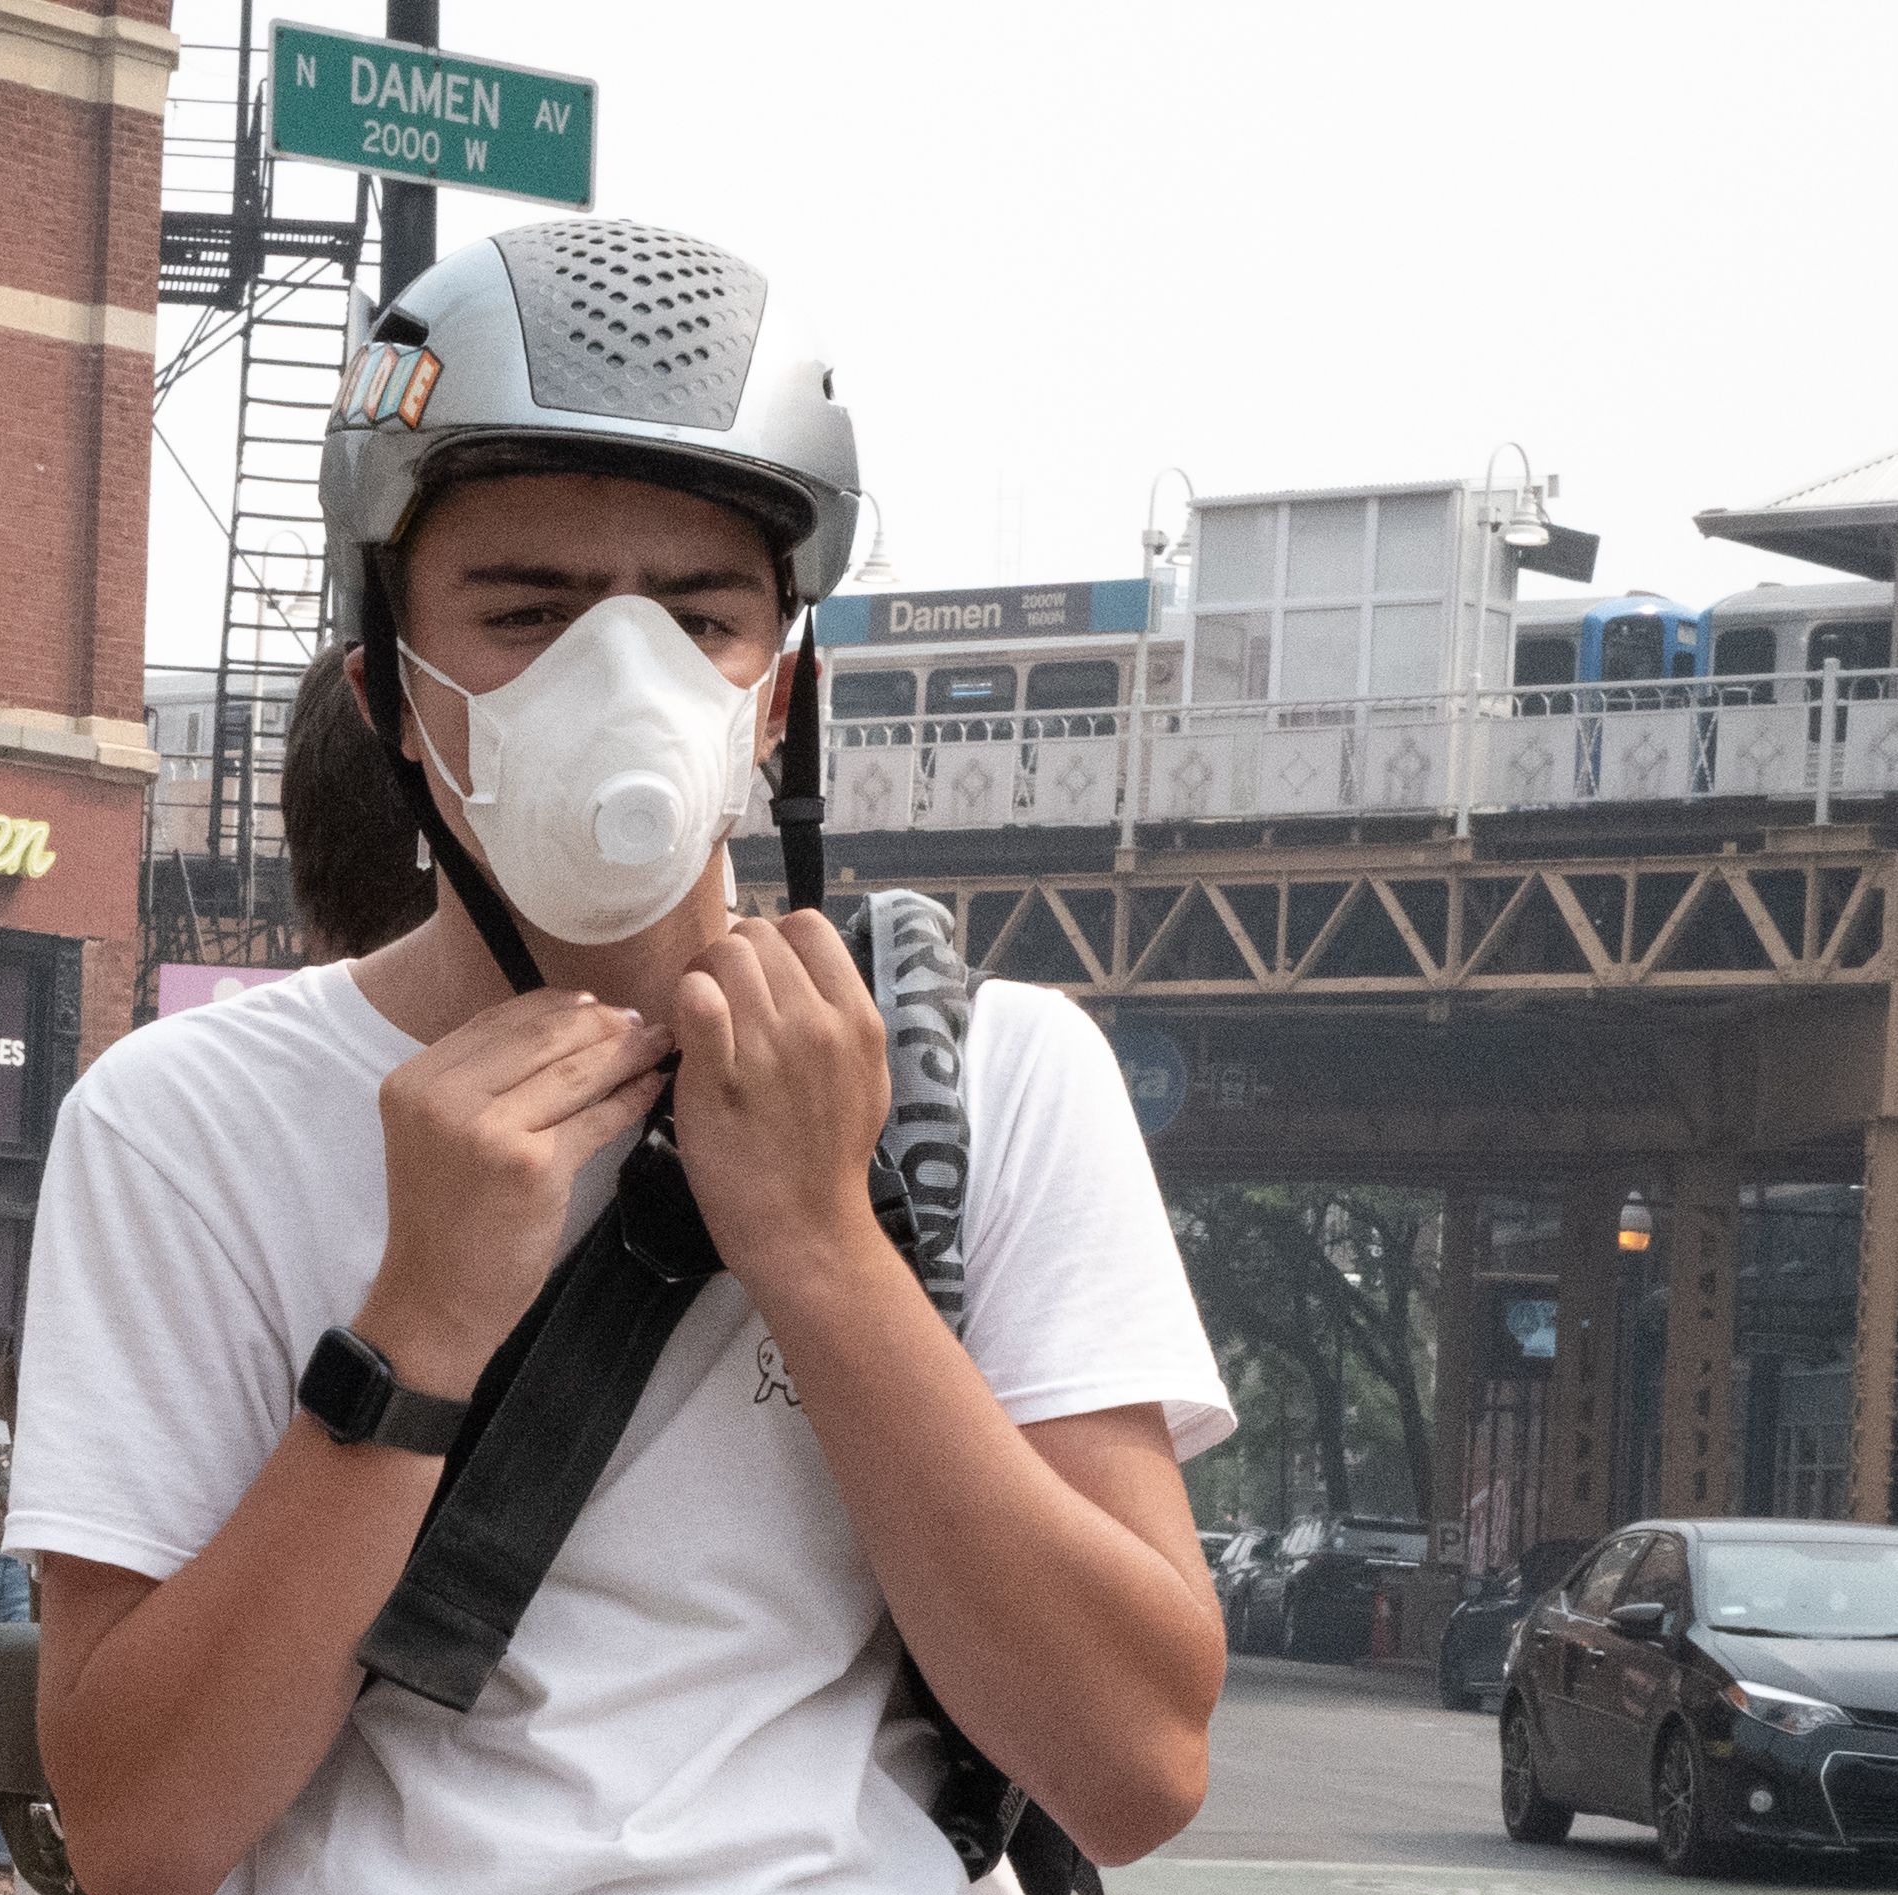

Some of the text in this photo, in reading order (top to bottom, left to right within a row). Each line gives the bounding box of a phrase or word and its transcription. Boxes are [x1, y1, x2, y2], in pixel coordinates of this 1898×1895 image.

[297, 54, 571, 135] N DAMEN AV
[362, 120, 488, 172] 2000 W
[890, 600, 1002, 632] Damen
[1021, 592, 1067, 609] 2000W
